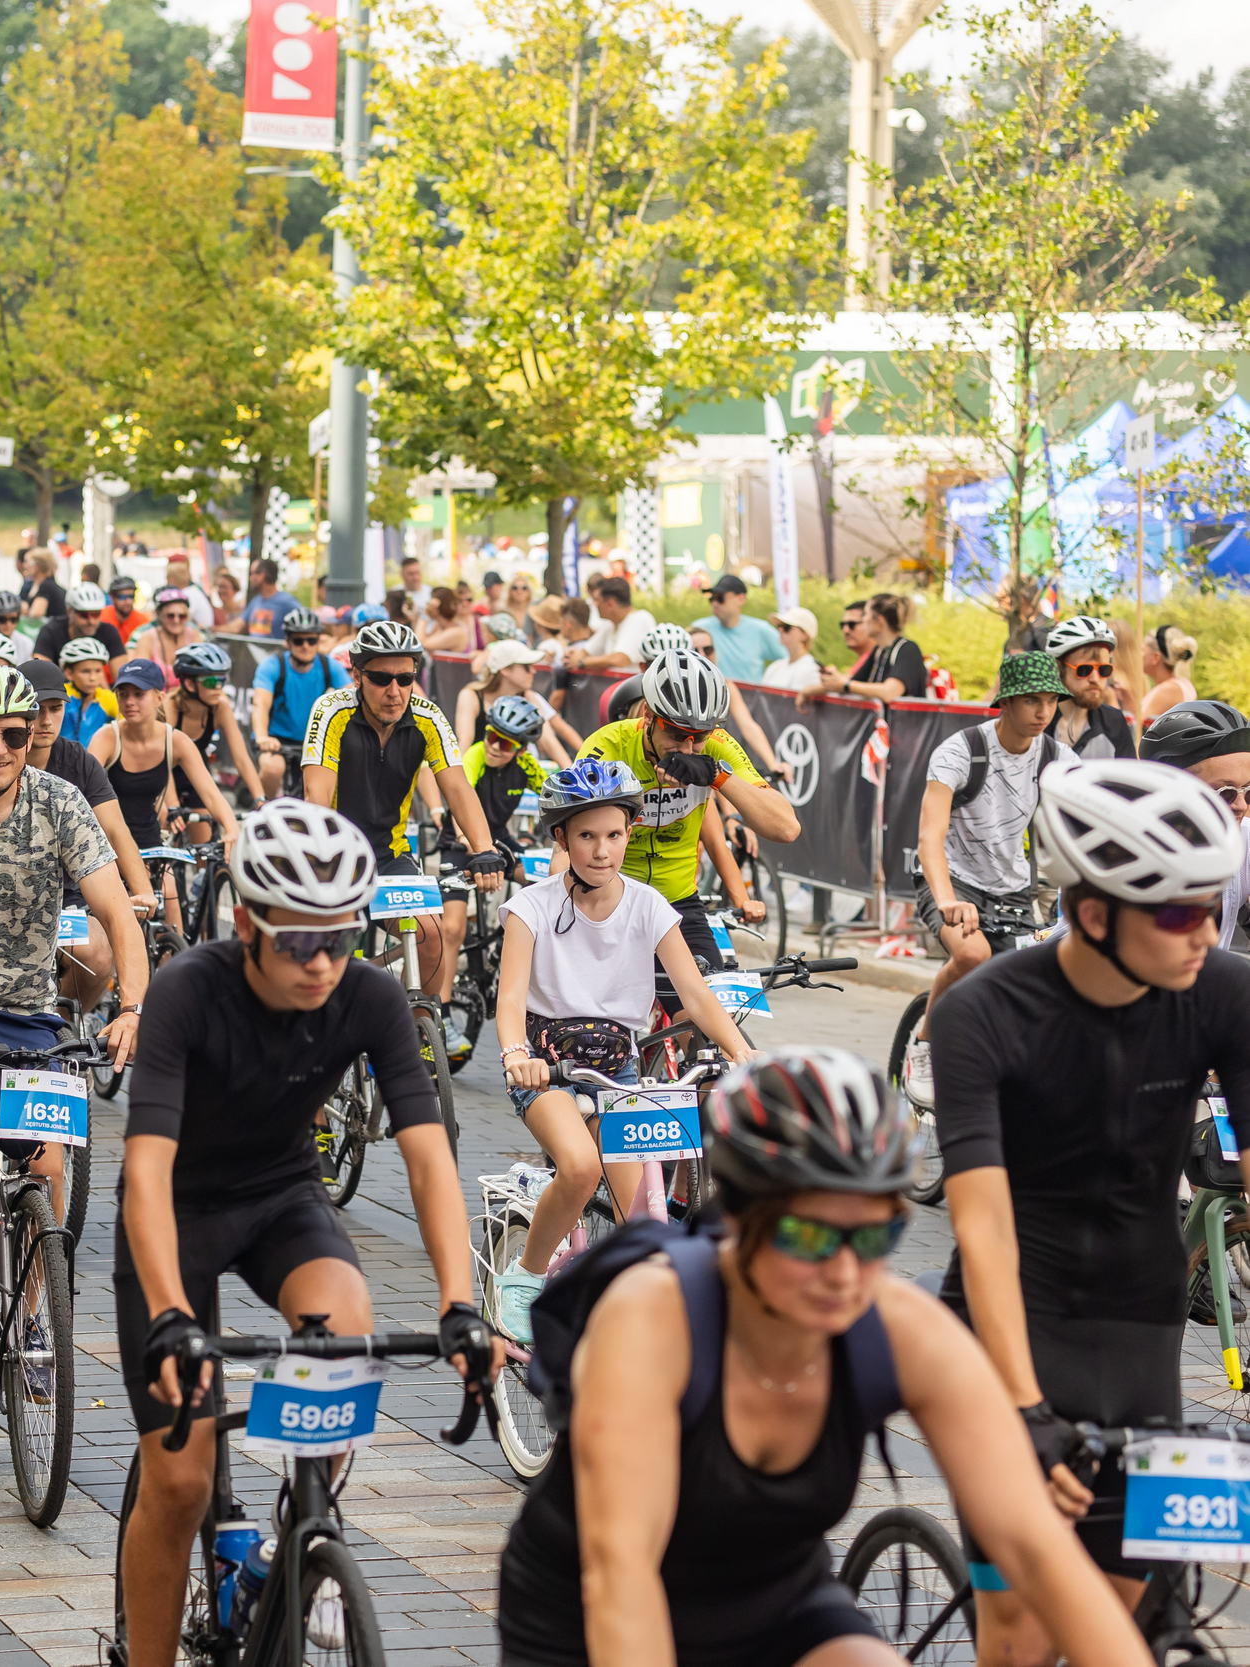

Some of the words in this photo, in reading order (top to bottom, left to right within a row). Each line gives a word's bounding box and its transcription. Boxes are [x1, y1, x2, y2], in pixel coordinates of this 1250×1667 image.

[303, 121, 330, 138] 700
[384, 890, 425, 905] 1596
[23, 1102, 71, 1125] 1634
[623, 1120, 682, 1143] 3068
[279, 1400, 357, 1431] 5968
[1162, 1493, 1238, 1529] 3931
